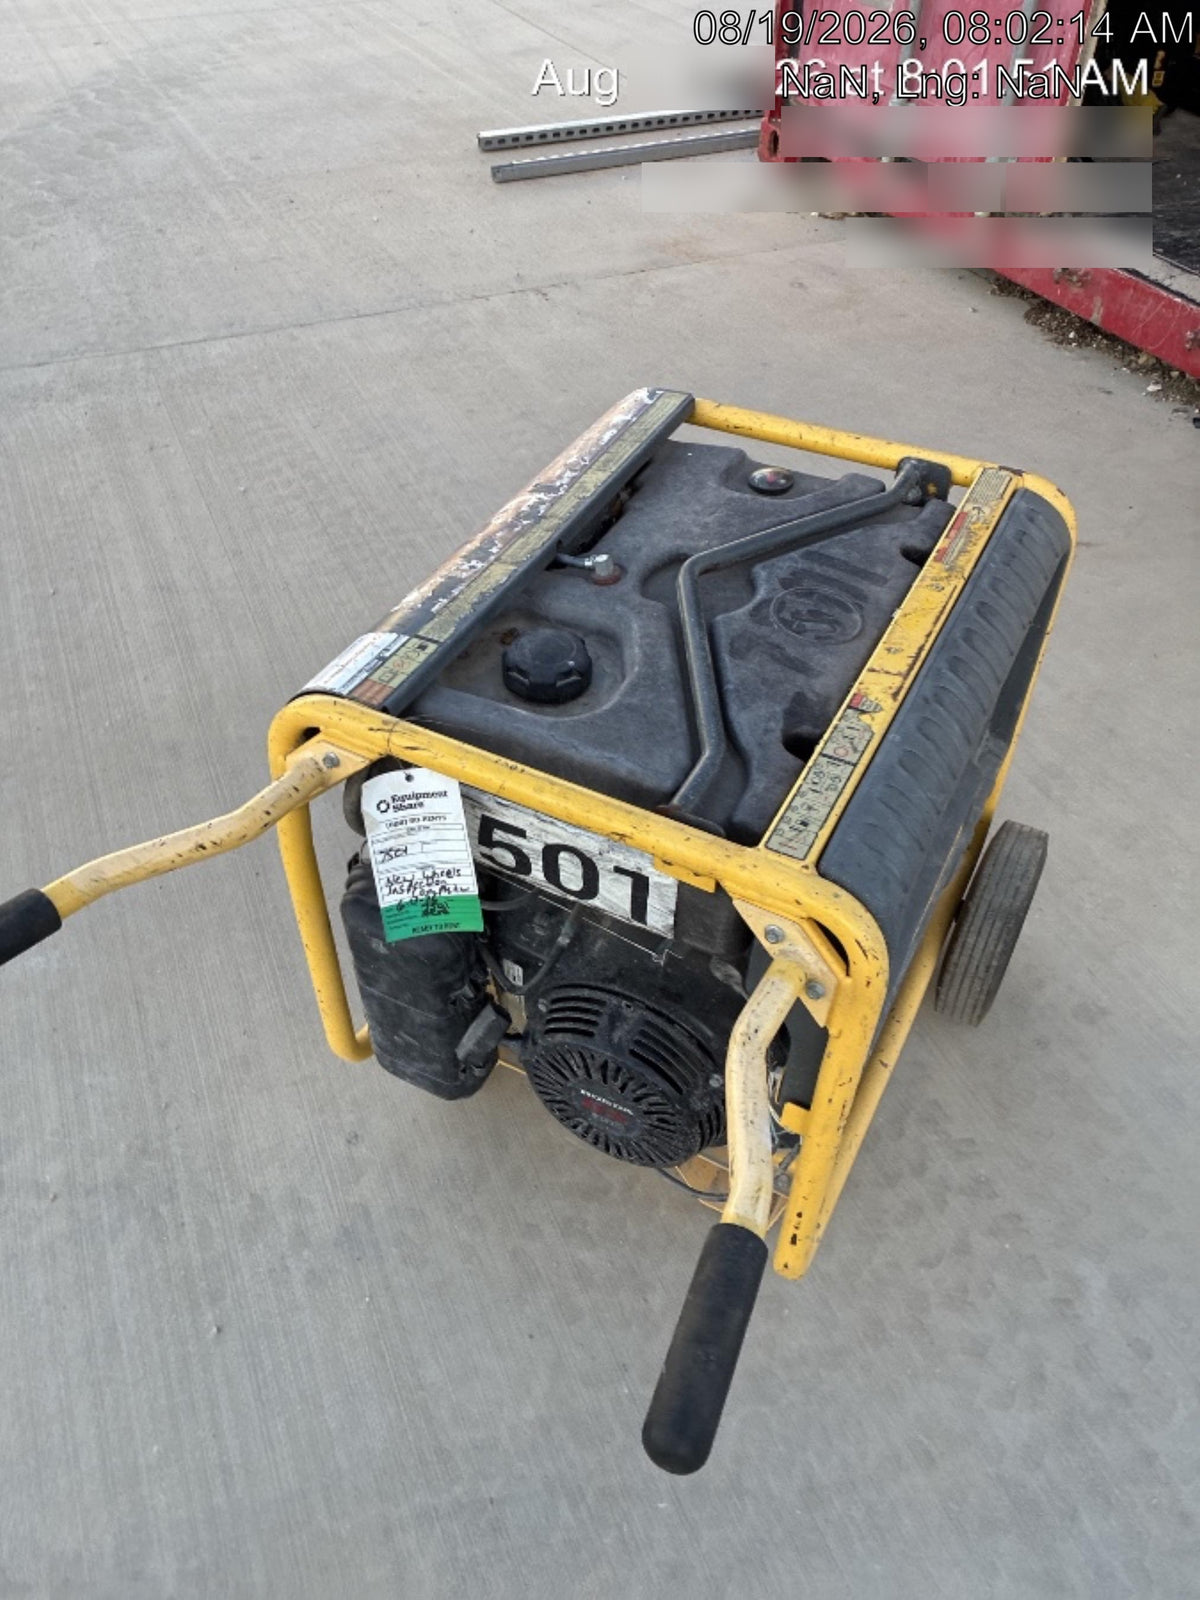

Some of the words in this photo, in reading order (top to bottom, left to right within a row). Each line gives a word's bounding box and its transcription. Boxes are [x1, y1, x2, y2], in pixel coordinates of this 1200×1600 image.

[390, 790, 448, 803] Equipment
[391, 802, 425, 813] Share
[478, 813, 650, 926] 501
